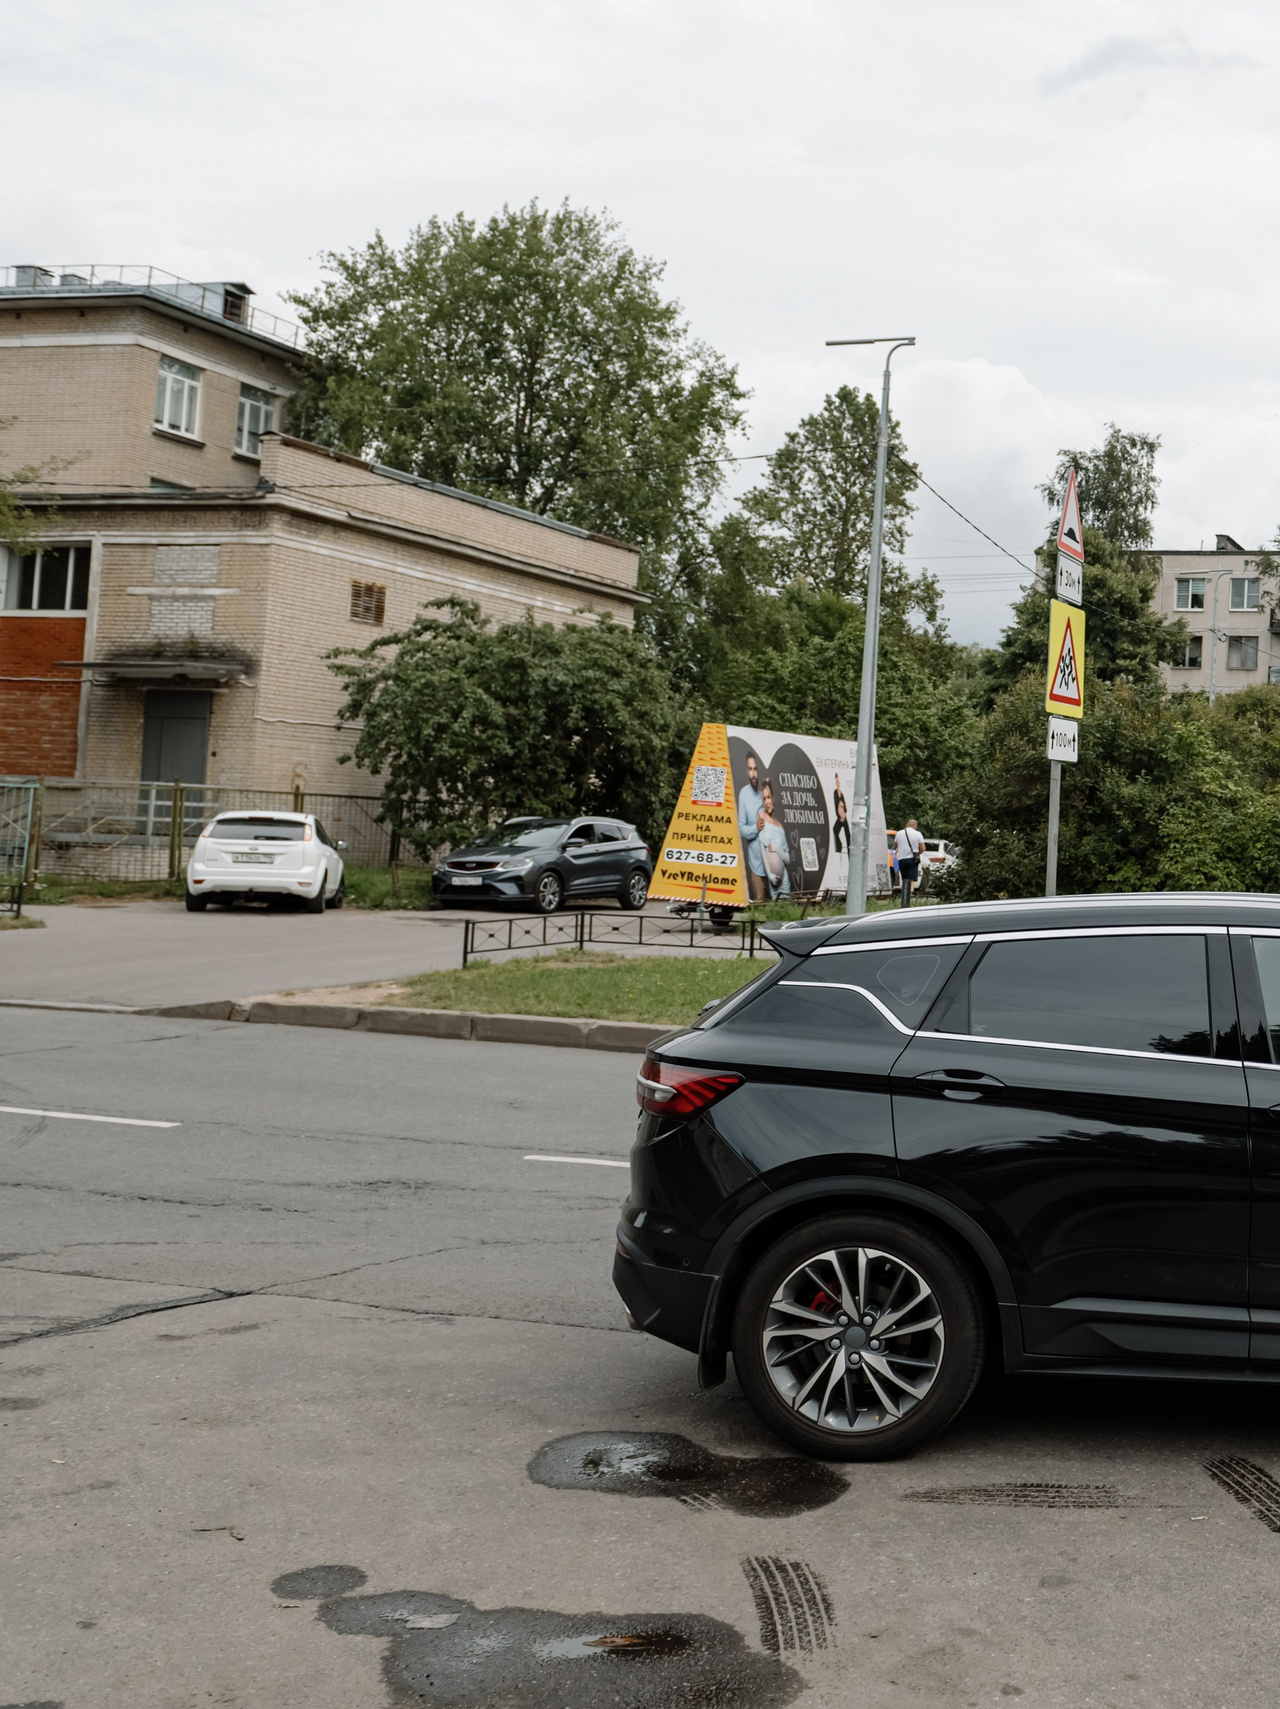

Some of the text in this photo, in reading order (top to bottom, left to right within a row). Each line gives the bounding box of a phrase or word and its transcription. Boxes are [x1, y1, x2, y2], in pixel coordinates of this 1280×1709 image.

[778, 772, 818, 790] СПАСИБО
[780, 791, 793, 805] ЗА
[677, 812, 733, 825] РЕКЛАМА
[783, 808, 826, 825] ЛЮБИМАЯ
[695, 824, 711, 833] НА
[671, 832, 734, 846] ПРИЦЕПАХ
[665, 849, 737, 866] 627-68-27
